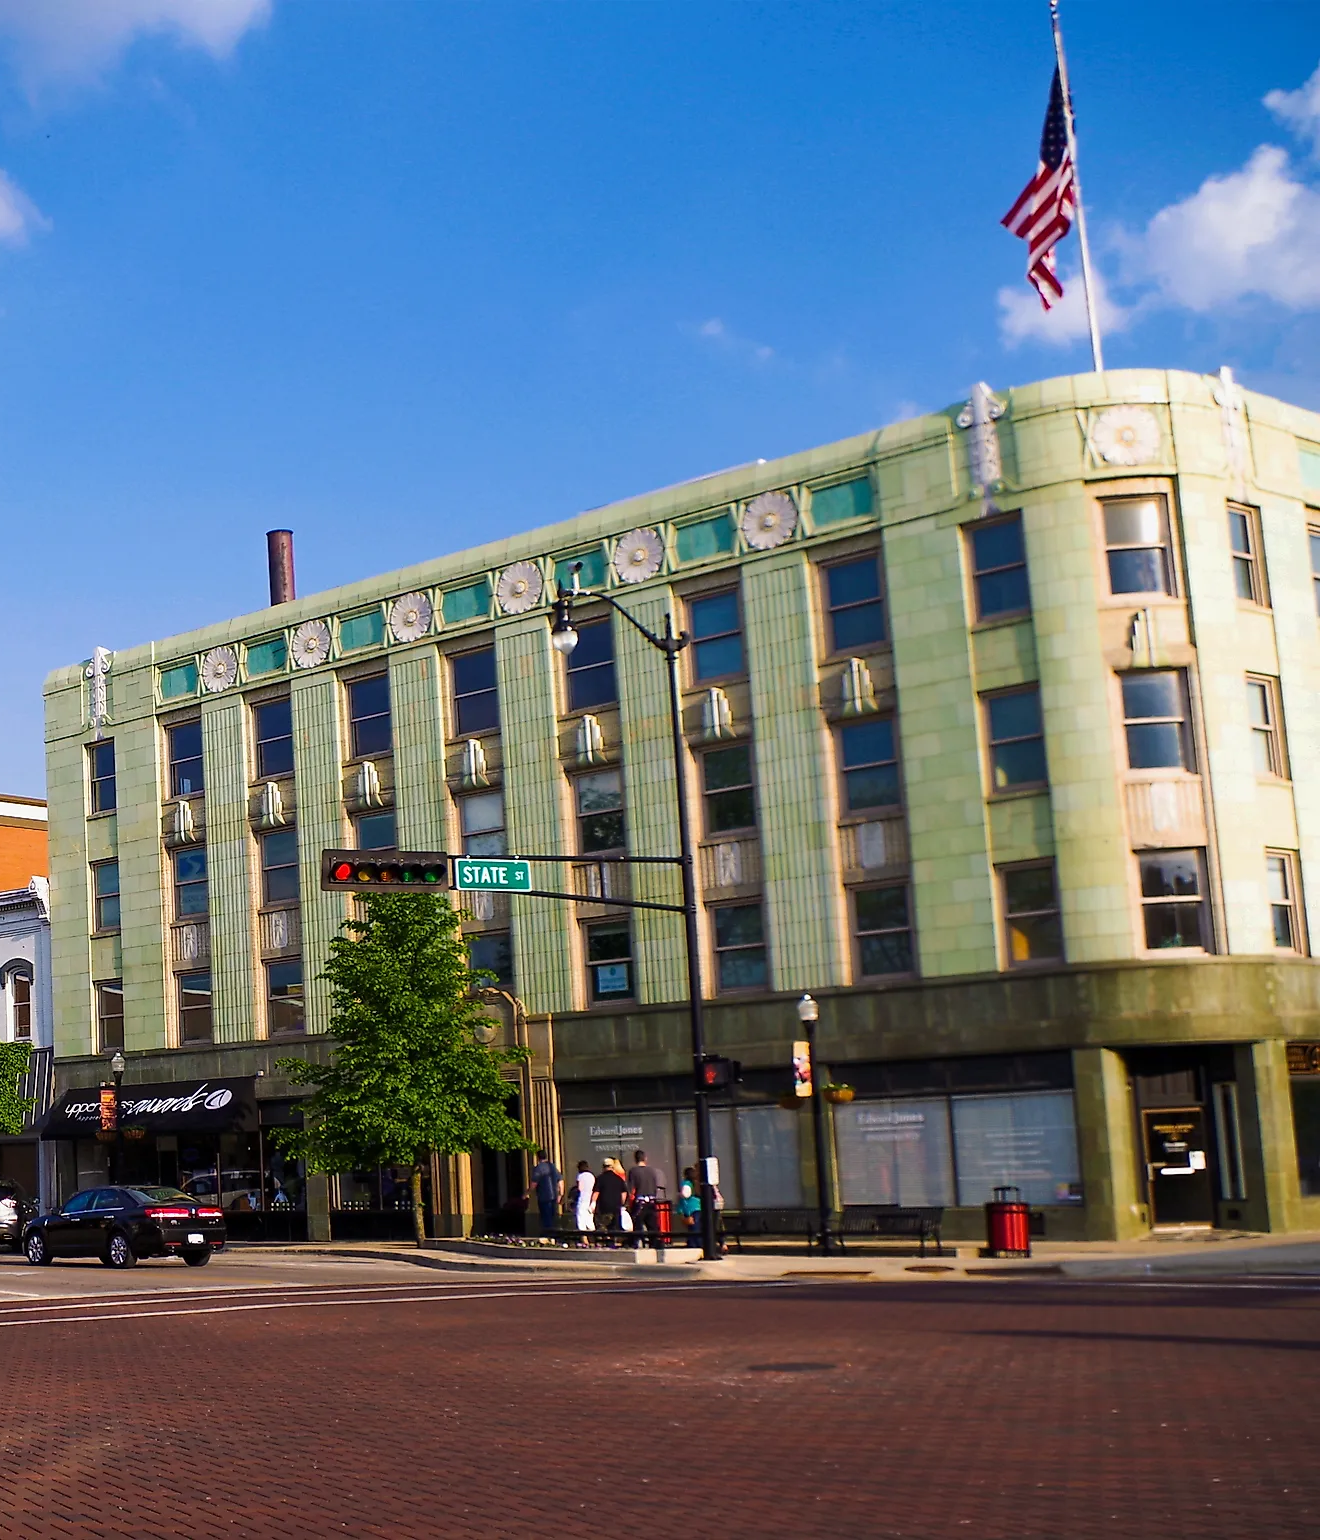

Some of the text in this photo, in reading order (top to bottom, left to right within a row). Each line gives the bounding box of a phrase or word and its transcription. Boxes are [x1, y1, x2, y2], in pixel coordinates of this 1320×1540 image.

[463, 865, 525, 885] STATE ST
[128, 1083, 209, 1115] awards
[618, 1124, 643, 1136] Jones
